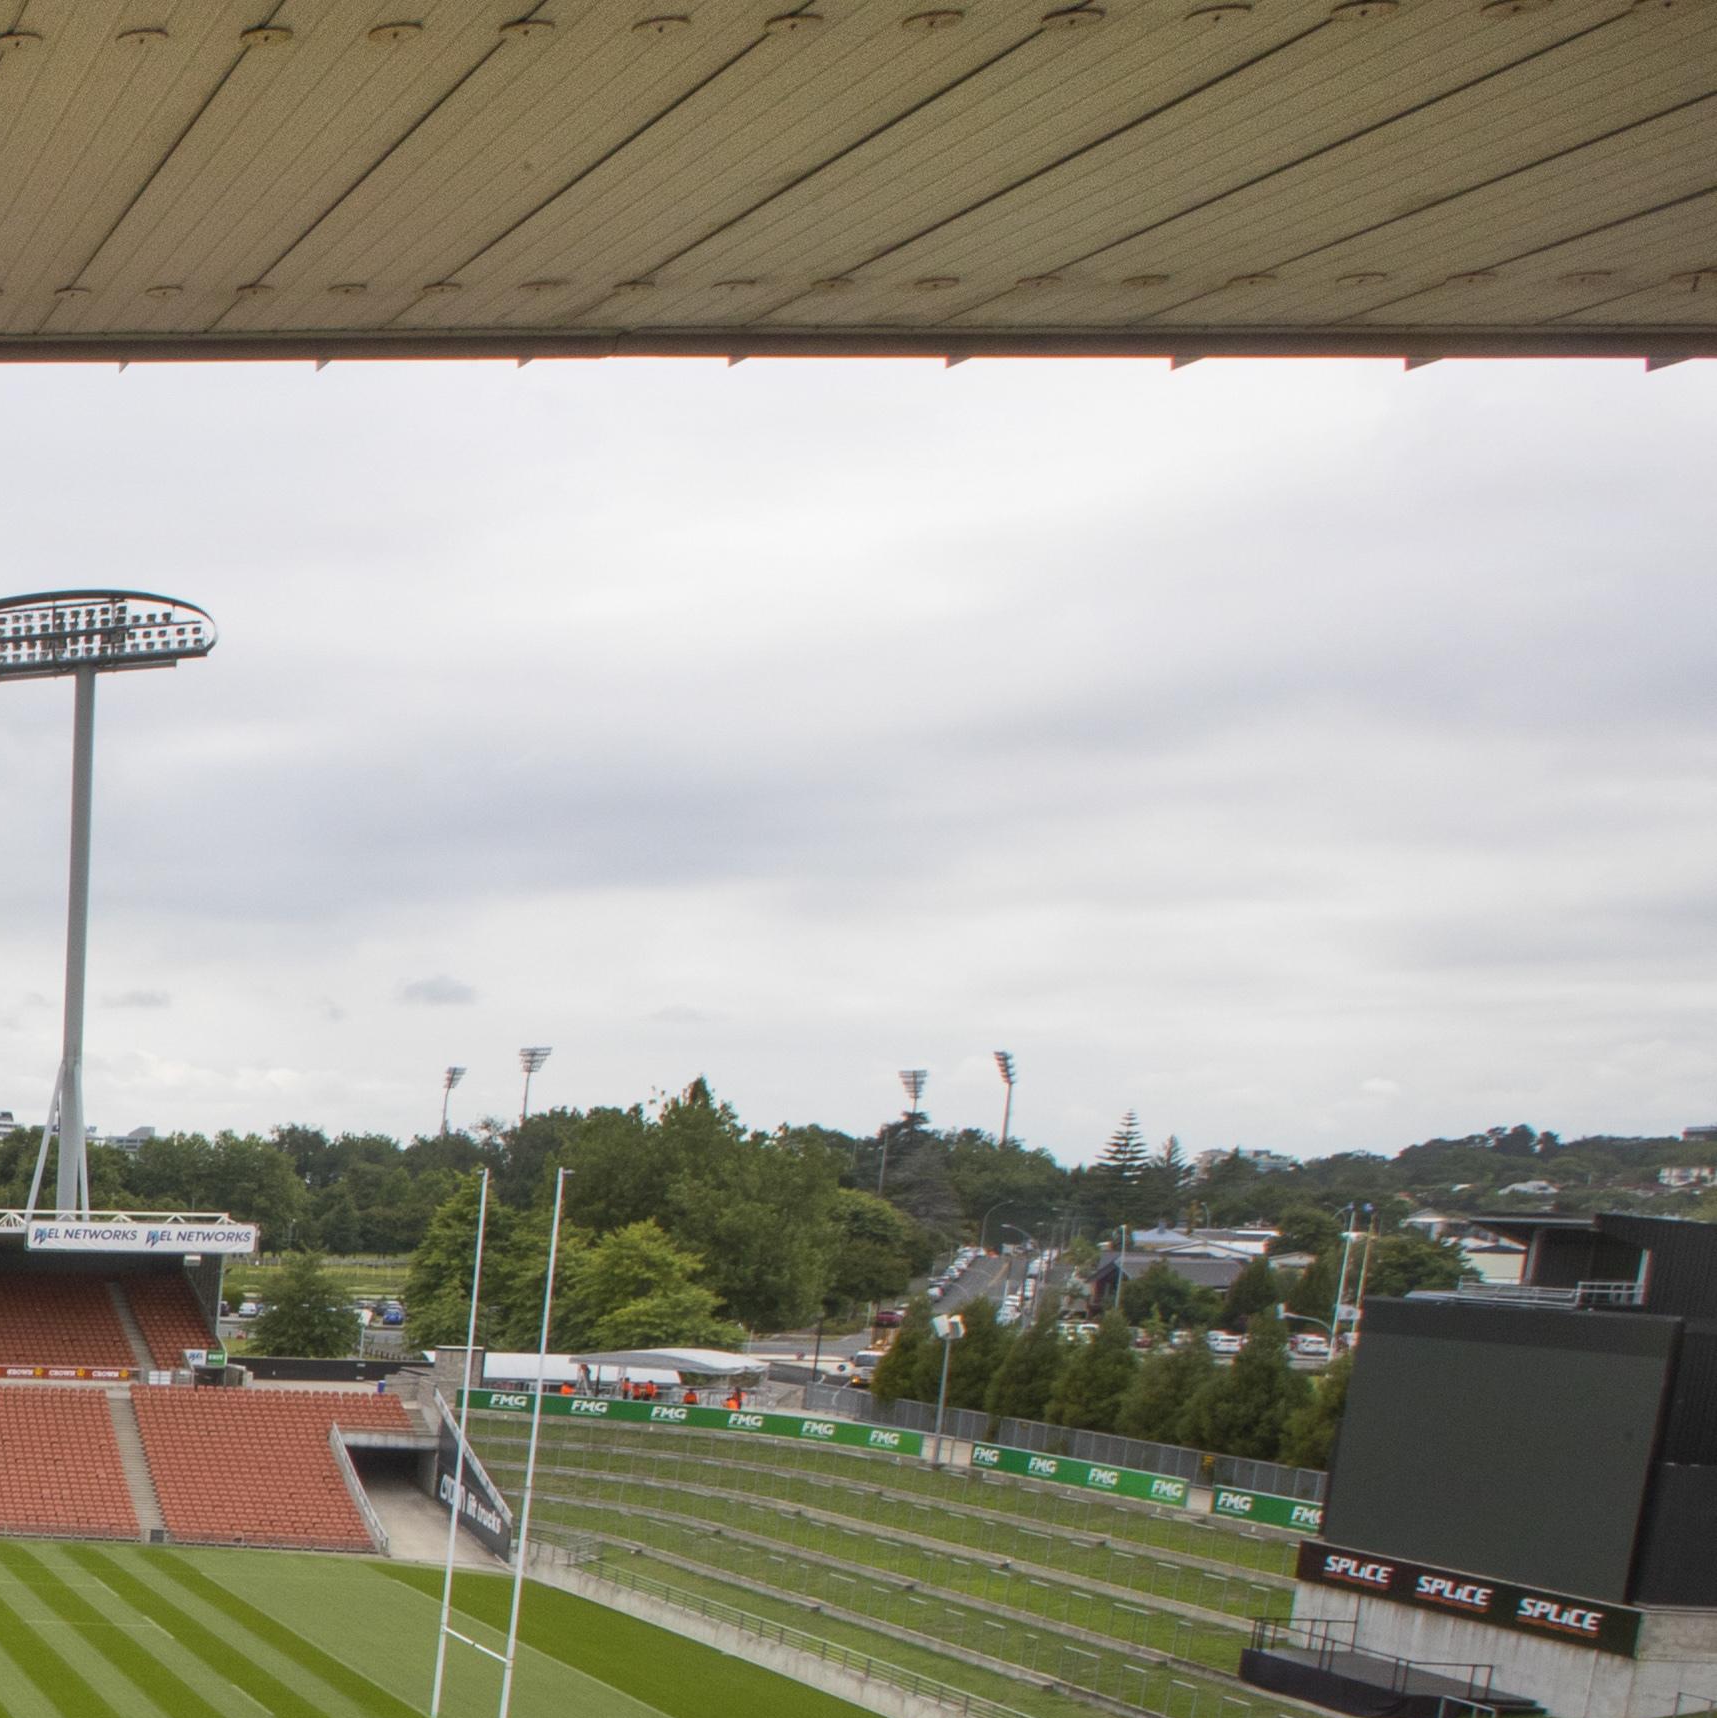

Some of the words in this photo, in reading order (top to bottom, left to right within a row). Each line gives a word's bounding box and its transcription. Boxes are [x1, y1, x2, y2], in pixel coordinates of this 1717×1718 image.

[63, 1228, 137, 1240] NETWORKS
[176, 1231, 250, 1243] NETWORKS
[489, 1393, 527, 1407] FMG
[571, 1400, 608, 1414] FMG
[650, 1406, 688, 1420] FMG
[728, 1413, 764, 1428] FMG
[802, 1421, 836, 1436] FMG
[870, 1430, 901, 1446] FMG
[973, 1447, 1000, 1462] FMG
[1028, 1456, 1058, 1473] FMG
[1088, 1467, 1119, 1485] FMG
[1151, 1479, 1184, 1498] FMG
[1217, 1491, 1253, 1511] FMG
[477, 1504, 502, 1534] trucks
